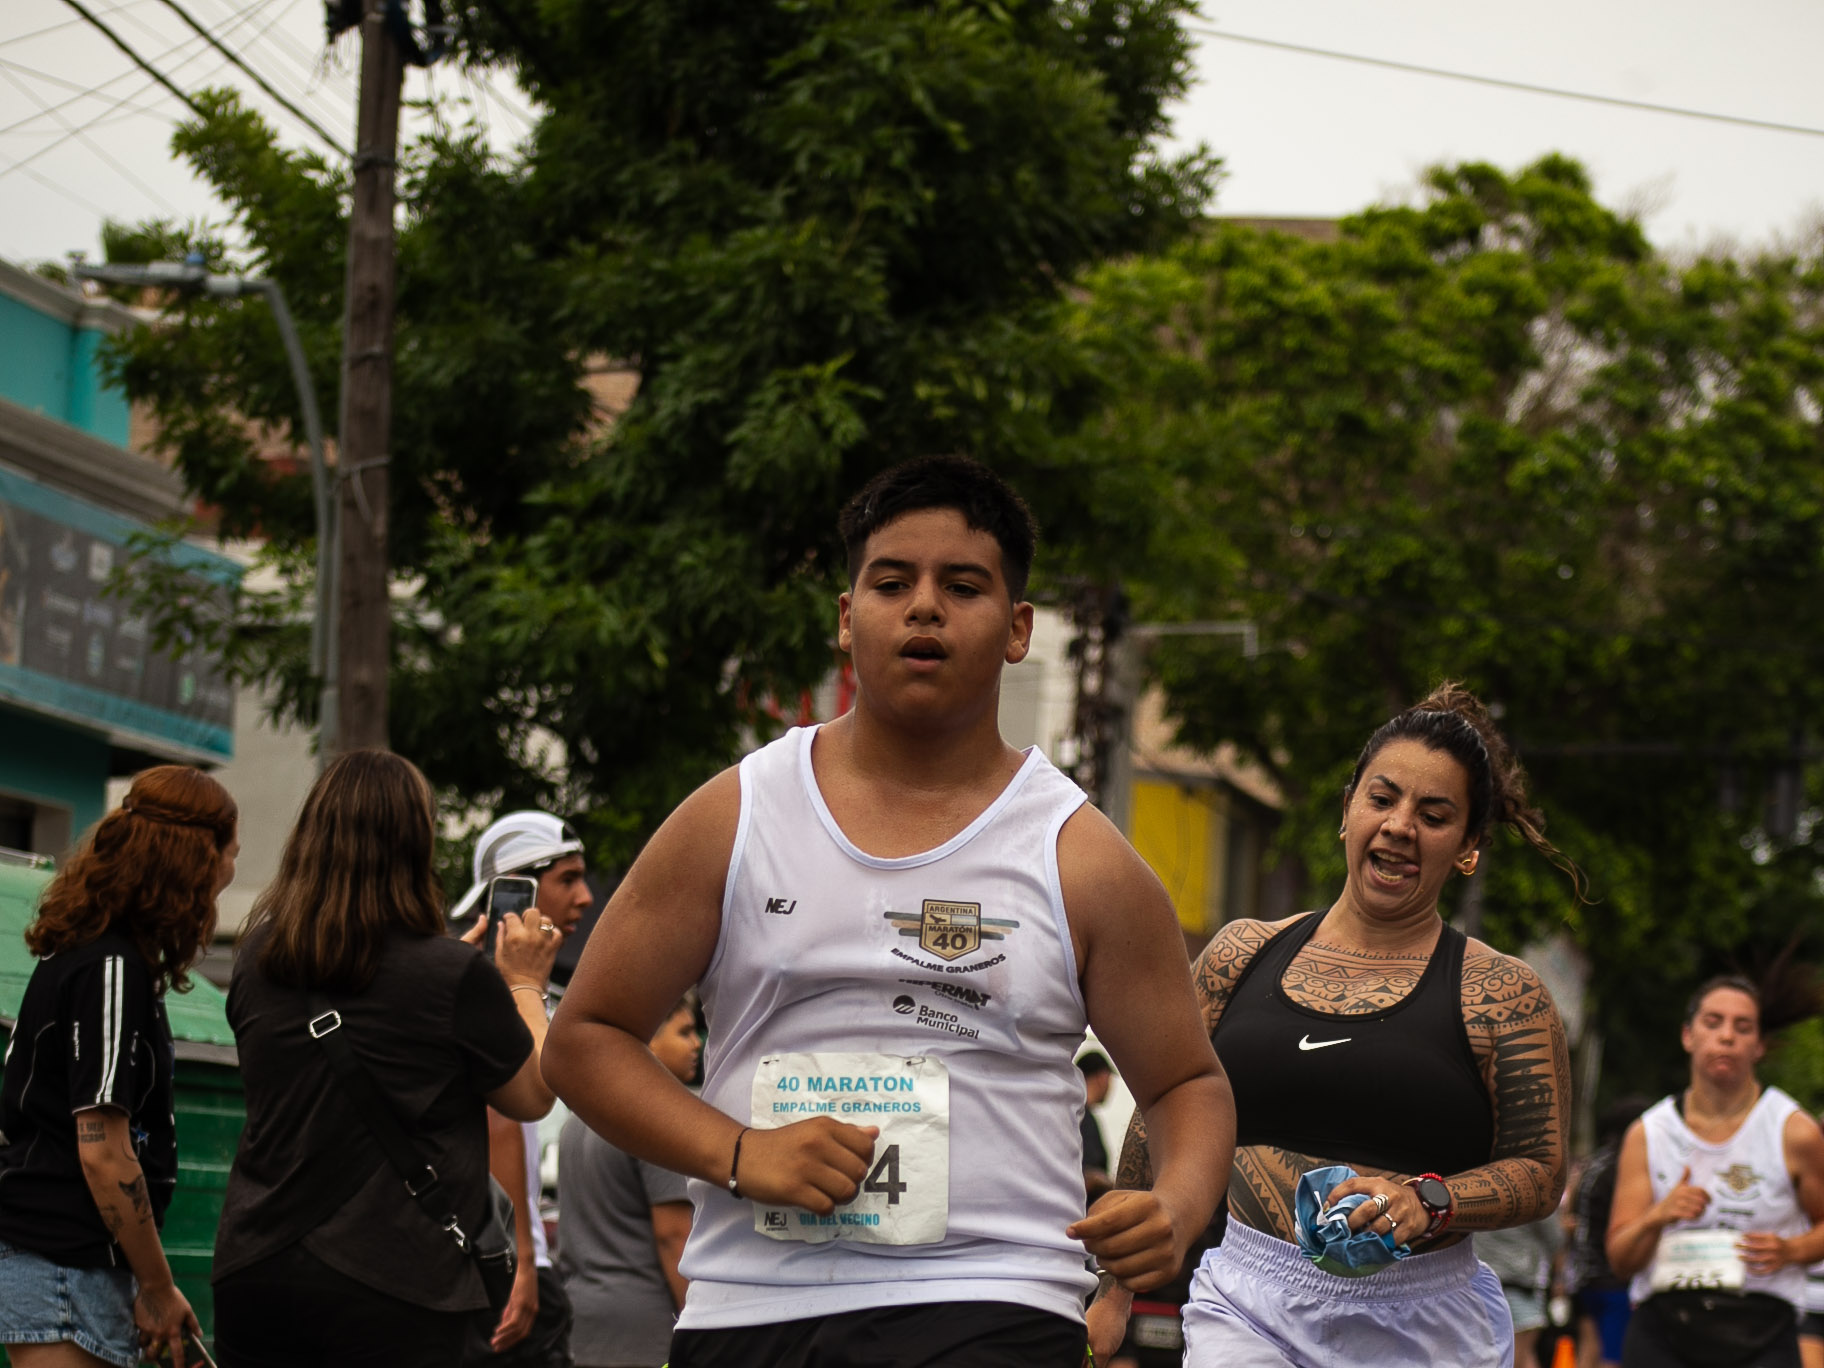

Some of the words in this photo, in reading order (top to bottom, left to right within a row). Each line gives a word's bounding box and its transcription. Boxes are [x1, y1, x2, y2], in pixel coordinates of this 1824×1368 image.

[765, 898, 797, 915] NEJ
[929, 905, 973, 915] ARGENTINA
[928, 925, 973, 934] MARATÓN
[932, 933, 968, 951] 40
[890, 947, 944, 973] EMPALME
[945, 953, 1006, 974] GRANEROS
[918, 1005, 958, 1023] Banco
[916, 1016, 980, 1040] Municipal
[776, 1076, 800, 1092] 40
[807, 1076, 914, 1092] MARATON
[772, 1102, 837, 1113] EMPALME
[841, 1102, 922, 1113] GRANEROS
[764, 1211, 787, 1227] NEJ
[839, 1213, 880, 1226] VECINO
